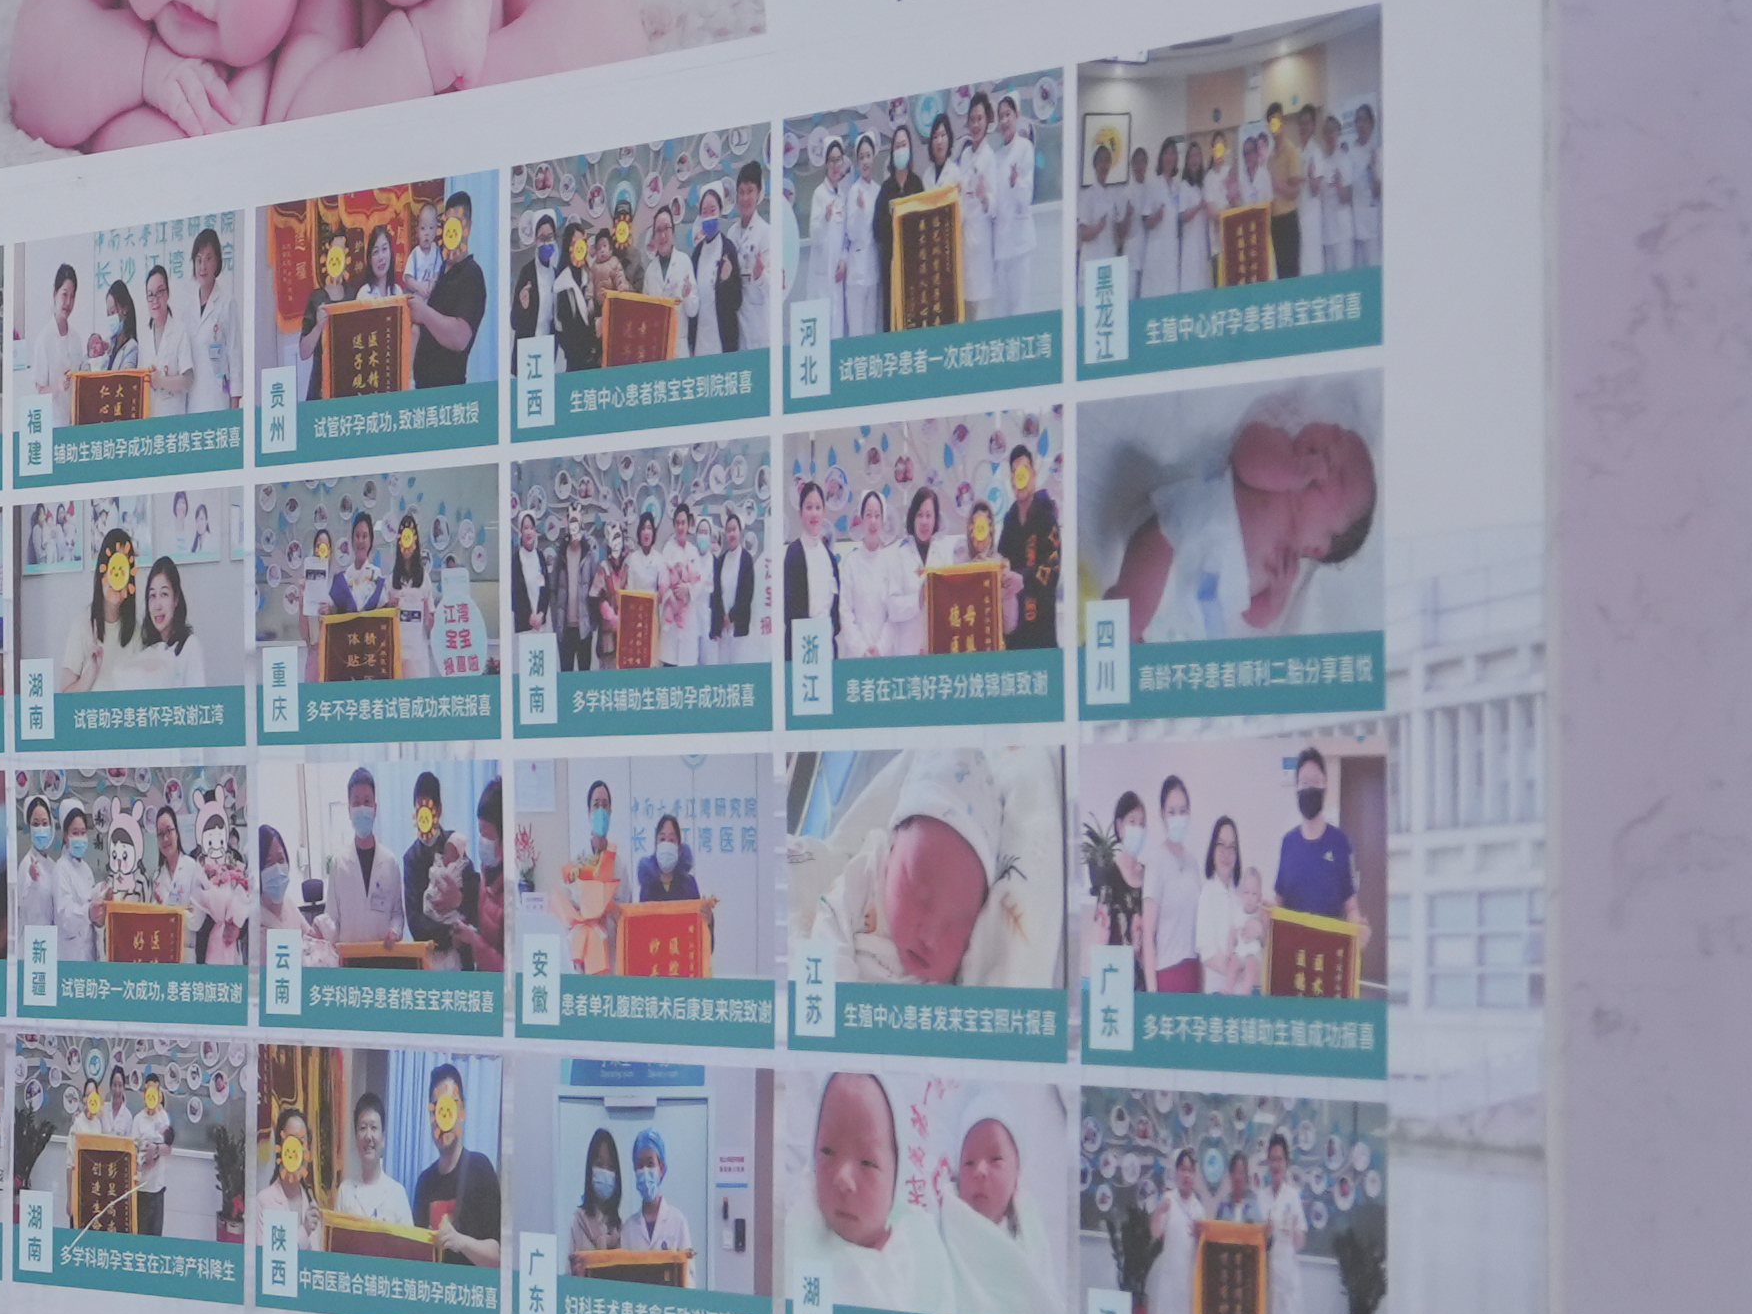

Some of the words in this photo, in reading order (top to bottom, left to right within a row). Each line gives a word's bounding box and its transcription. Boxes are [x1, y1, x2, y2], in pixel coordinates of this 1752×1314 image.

[1095, 265, 1116, 361] 黑龙江
[799, 317, 818, 385] 河北
[270, 382, 286, 443] 贵州
[526, 353, 544, 416] 江西
[26, 409, 42, 466] 福建
[528, 650, 545, 714] 湖南
[801, 635, 819, 703] 浙江
[1096, 621, 1115, 693] 四川
[29, 672, 43, 731] 湖南
[272, 663, 287, 722] 重庆
[32, 939, 46, 997] 新疆
[275, 945, 290, 1005] 云南
[532, 949, 548, 1015] 安徽
[806, 958, 824, 1025] 江苏
[1100, 965, 1120, 1038] 广东
[28, 1205, 42, 1262] 湖南
[271, 1225, 286, 1285] 陕西
[529, 1249, 545, 1313] 广东
